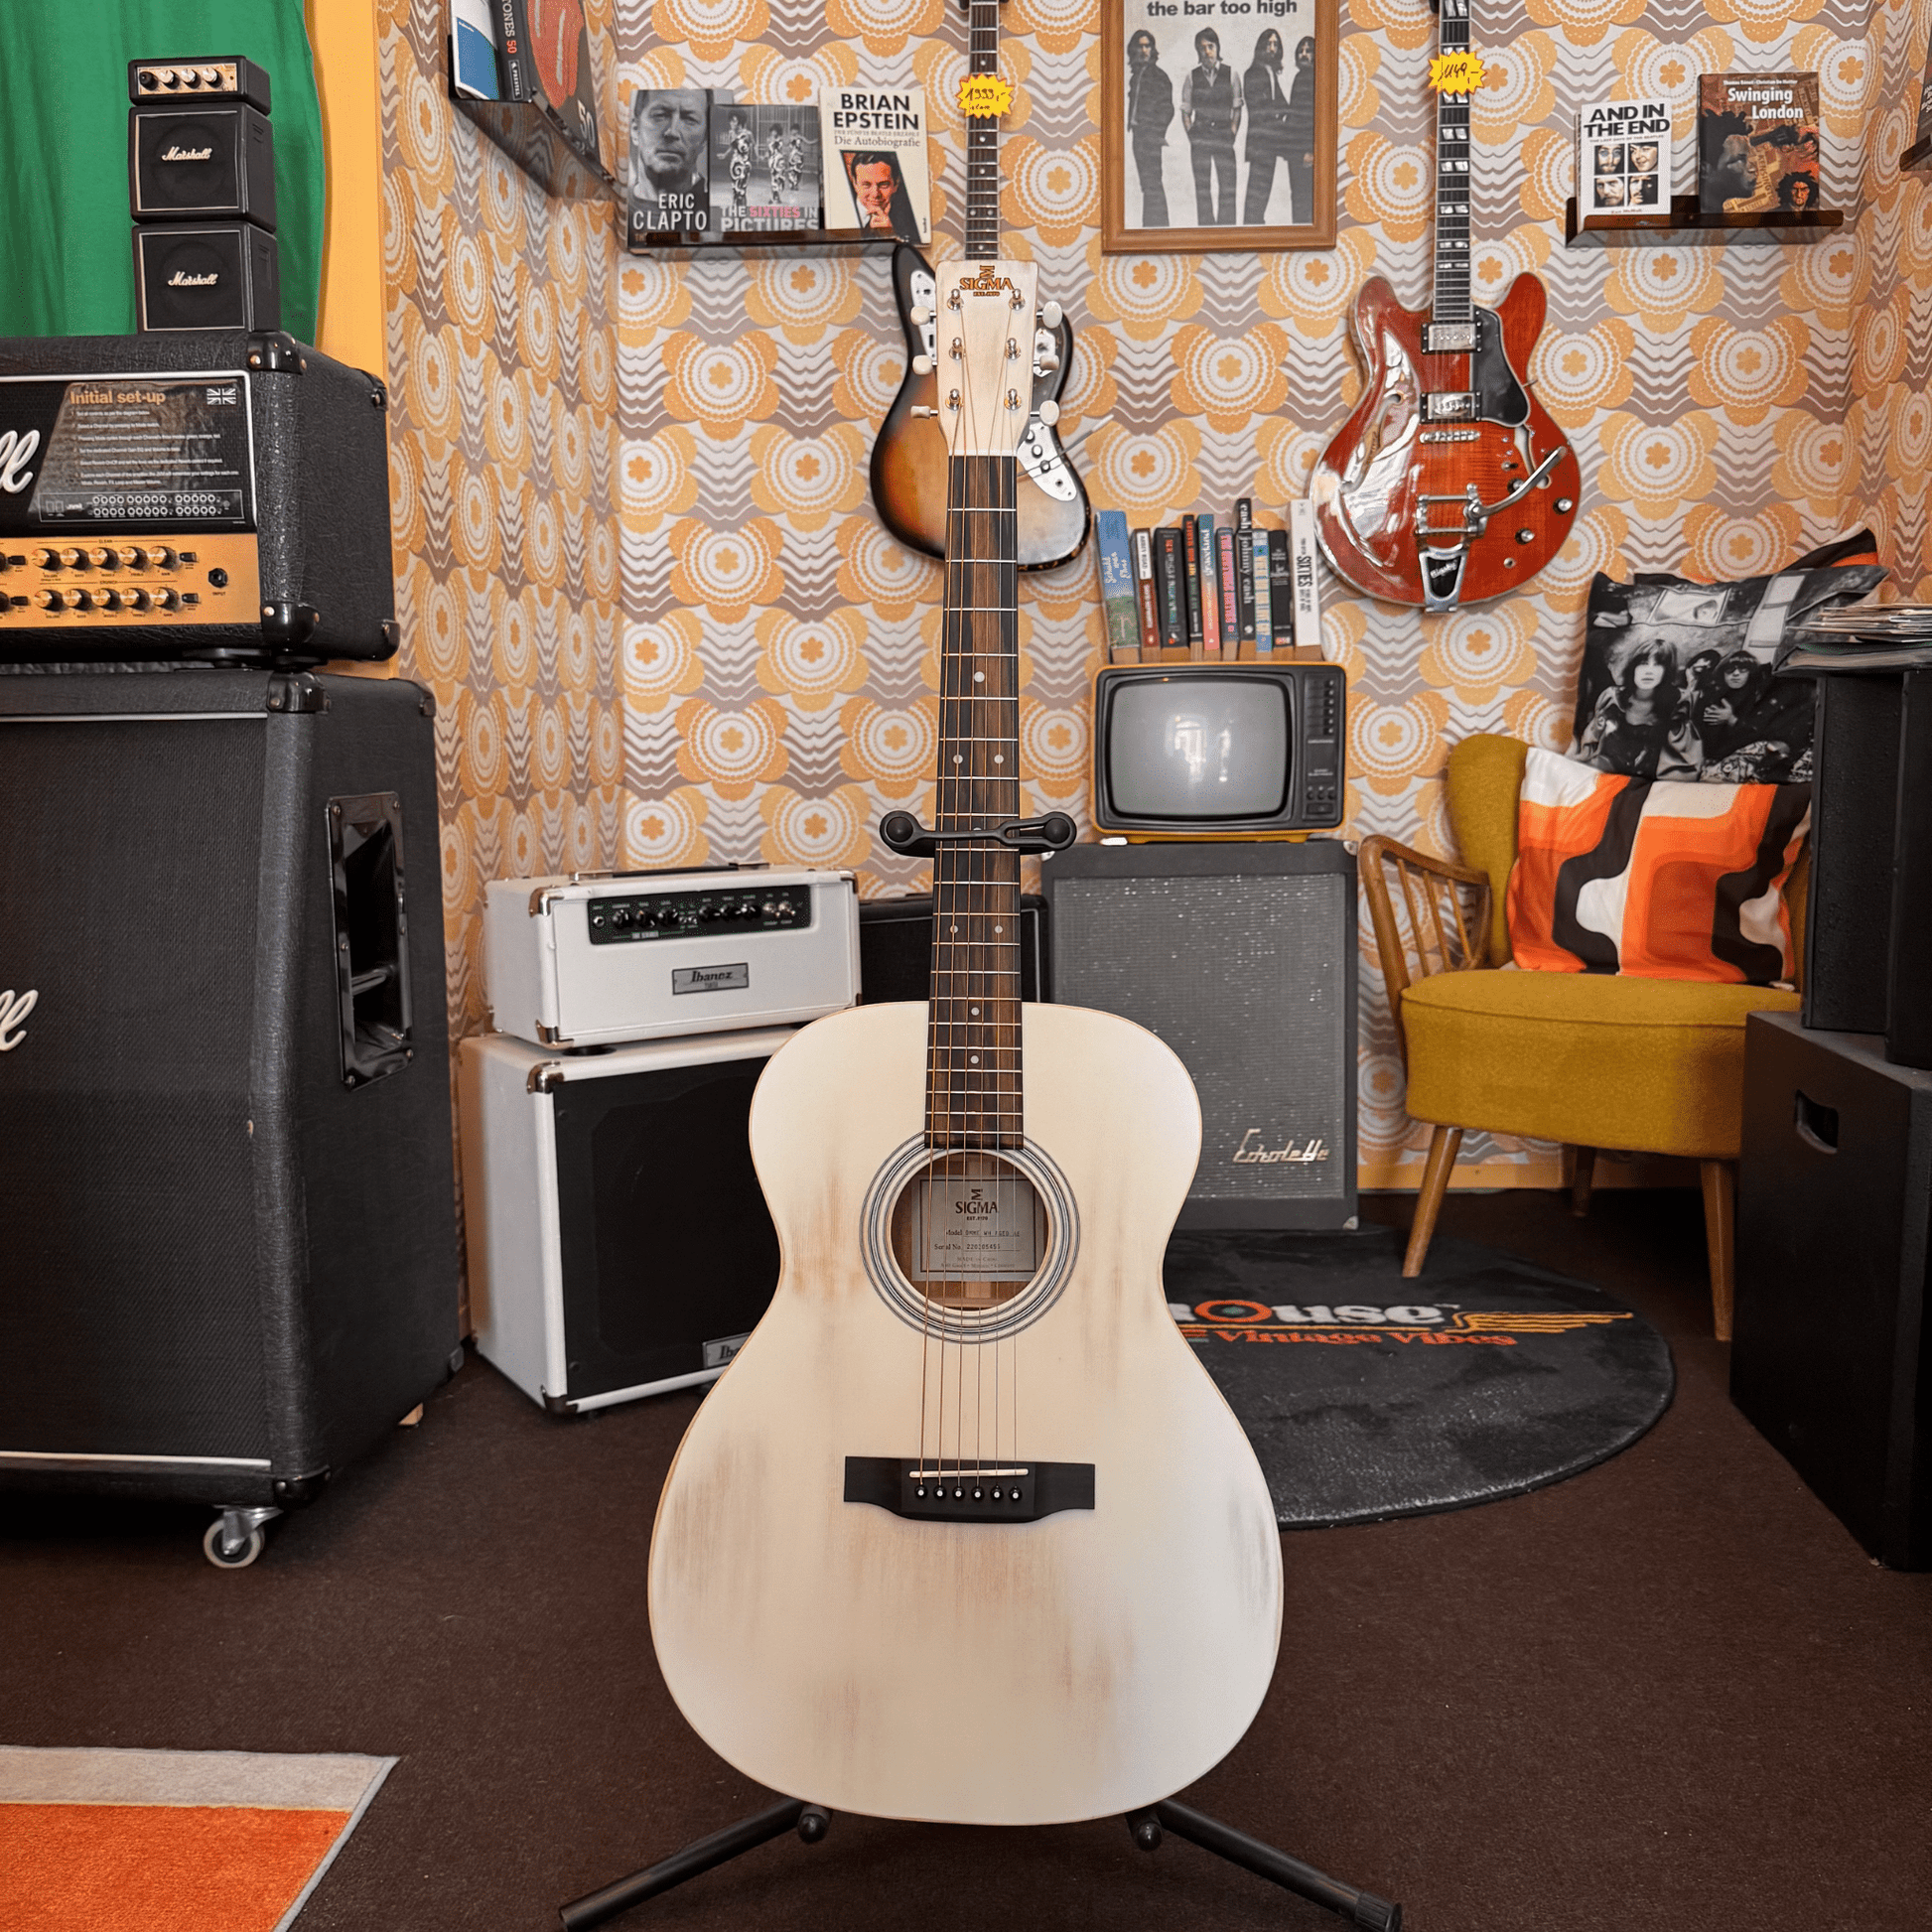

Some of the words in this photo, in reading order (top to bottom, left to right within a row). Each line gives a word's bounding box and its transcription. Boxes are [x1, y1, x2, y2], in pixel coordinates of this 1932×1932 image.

[1147, 1, 1178, 16] the
[1183, 1, 1215, 15] bar
[1220, 1, 1251, 15] too
[1256, 0, 1298, 17] high
[841, 93, 910, 111] BRIAN
[1727, 87, 1793, 104] Swinging
[1589, 105, 1638, 123] AND
[1643, 103, 1665, 119] IN
[1751, 105, 1804, 119] London
[833, 111, 919, 130] EPSTEIN
[1584, 122, 1624, 138] THE
[1627, 119, 1670, 135] END
[834, 136, 852, 145] Die
[854, 136, 920, 149] Autobiografie
[162, 146, 212, 161] Marshall
[658, 193, 695, 209] ERIC
[721, 206, 746, 217] THE
[749, 206, 801, 218] SIXTIES
[804, 206, 818, 218] IN
[632, 210, 708, 231] CLAPTO
[720, 217, 819, 232] PICTURES
[168, 271, 218, 287] Marshall
[959, 277, 1014, 291] SIGMA
[69, 390, 113, 405] Initial
[117, 391, 166, 406] set-up
[1238, 535, 1253, 576] johnny
[1296, 555, 1312, 587] SIXTIES
[1243, 578, 1255, 604] cash
[691, 970, 733, 983] Ibanez
[955, 1201, 998, 1213] SIGMA
[1213, 1329, 1383, 1344] Vintage
[1390, 1331, 1518, 1347] Vibes
